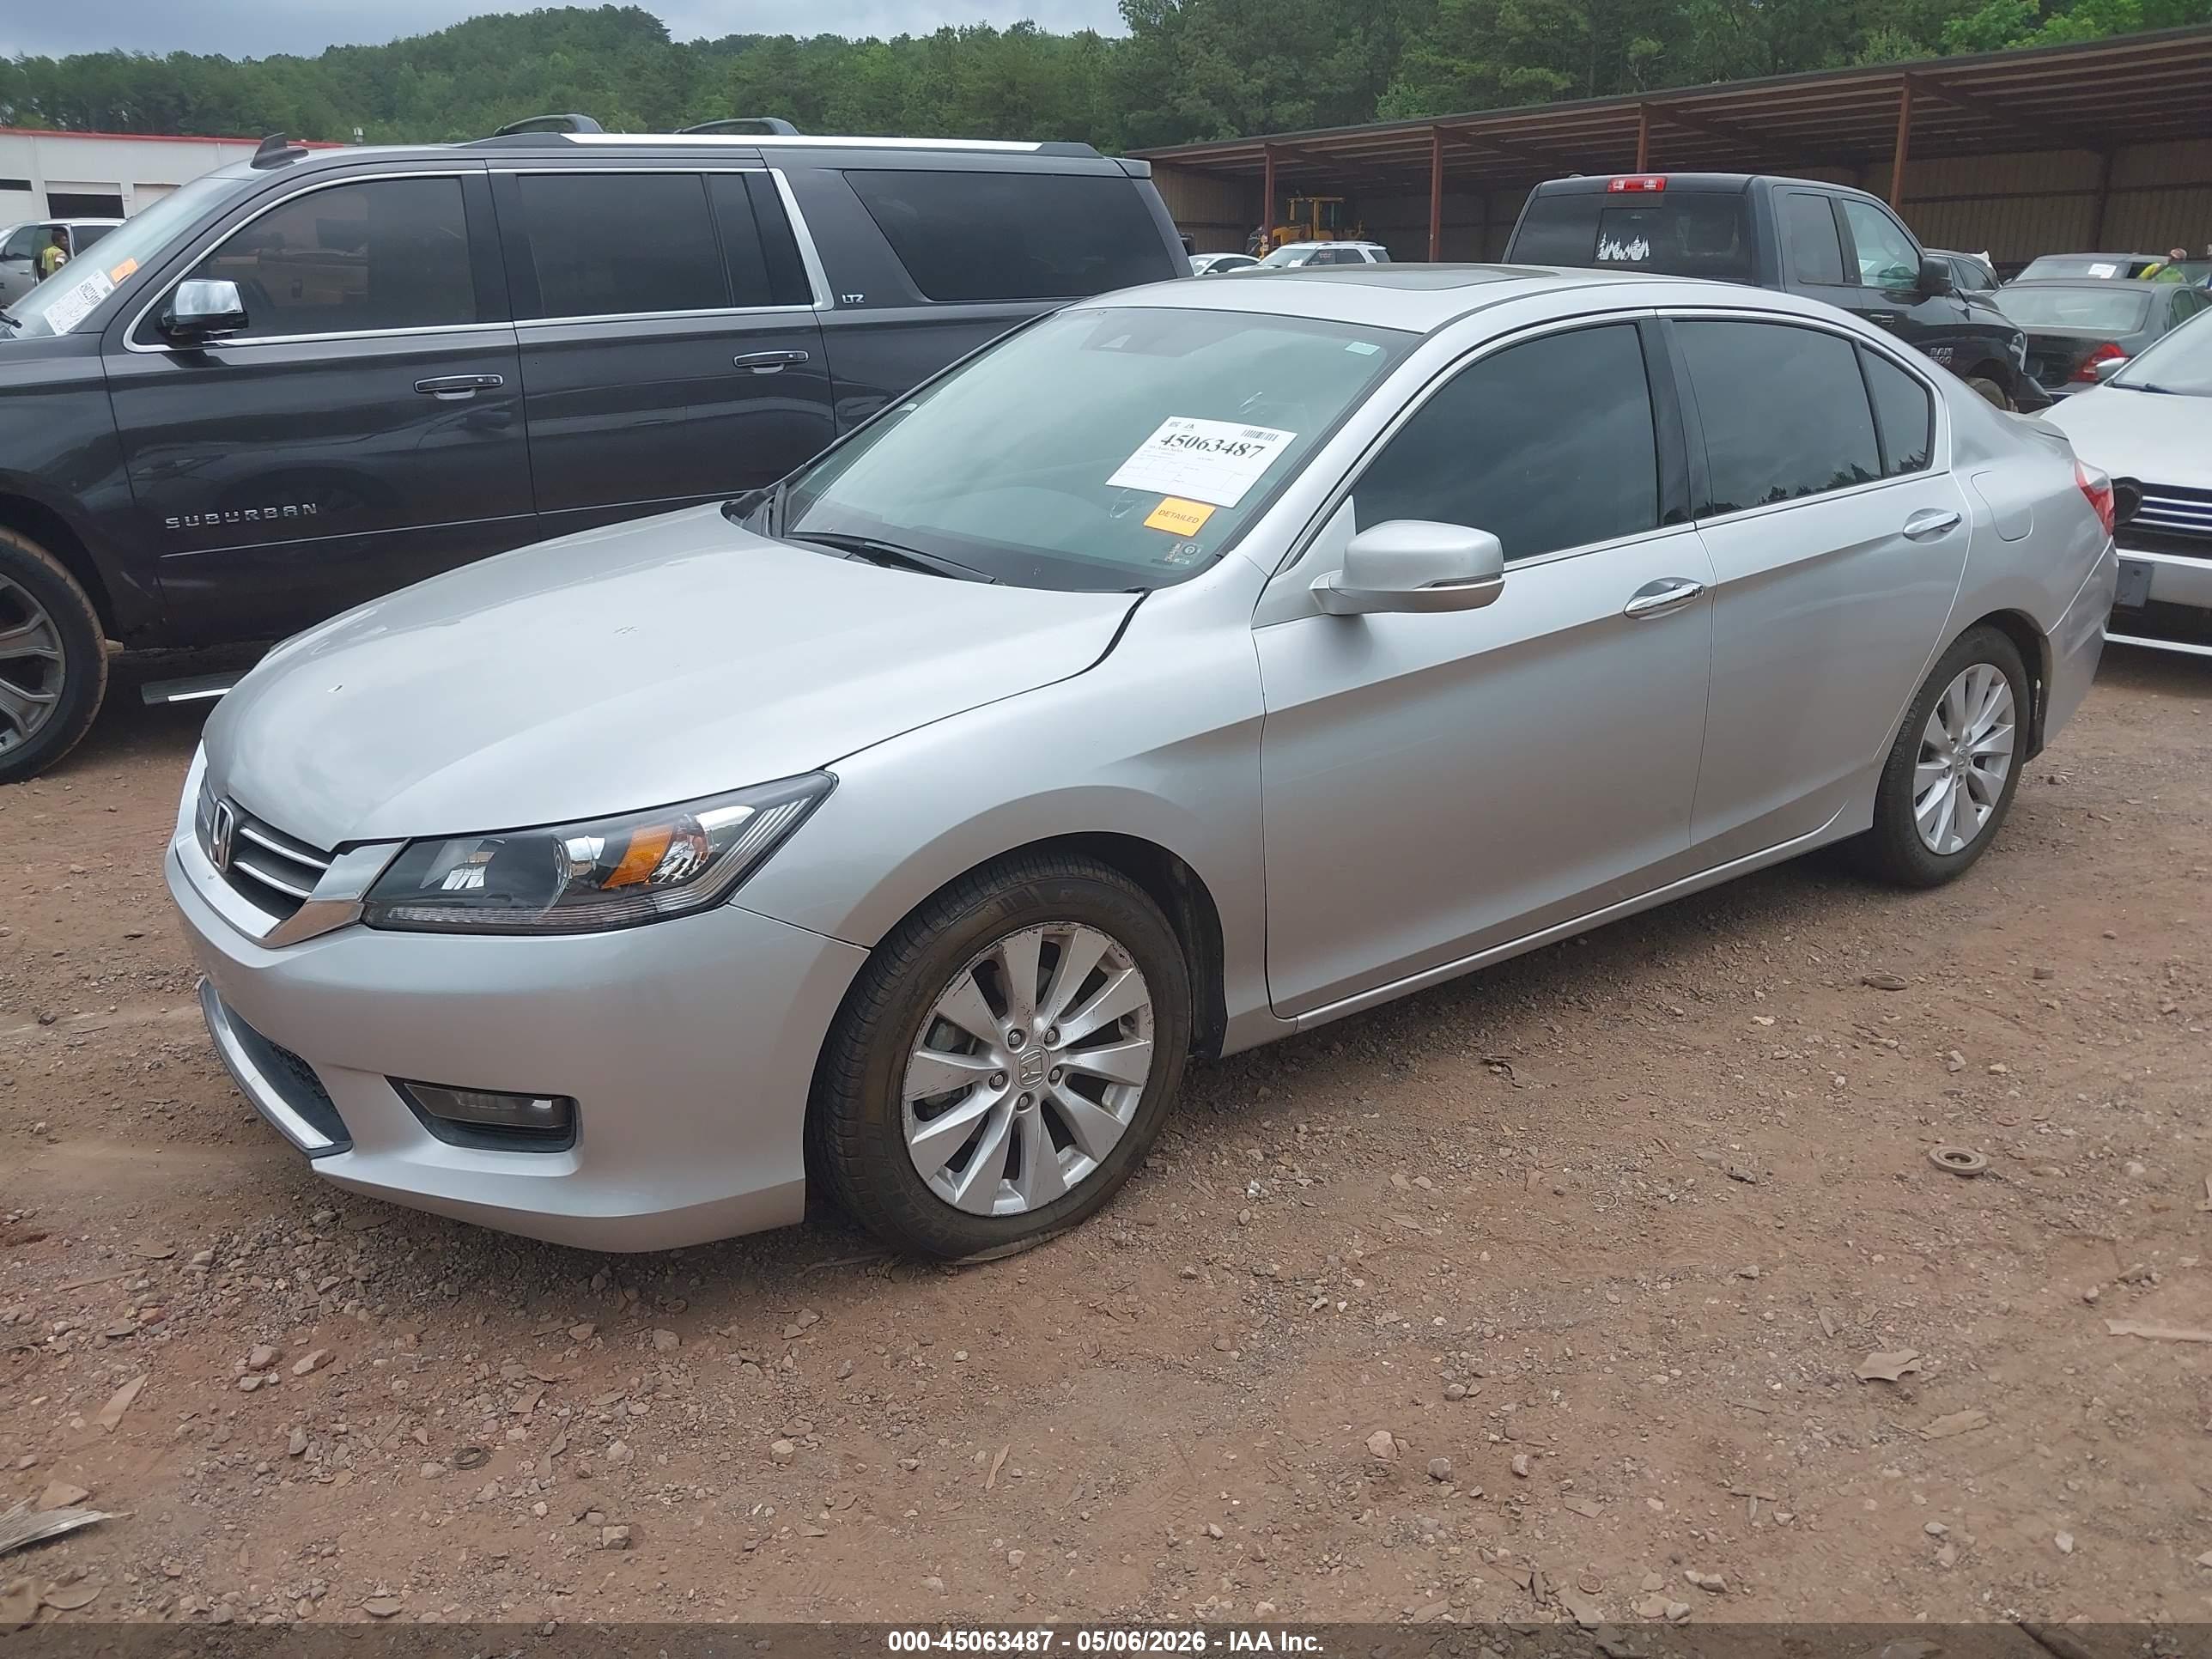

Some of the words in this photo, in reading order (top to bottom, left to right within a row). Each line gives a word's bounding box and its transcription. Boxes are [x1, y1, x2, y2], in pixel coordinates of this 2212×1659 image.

[842, 294, 865, 304] LTZ
[1929, 347, 1954, 356] RAM
[1160, 433, 1266, 459] 45063487
[165, 503, 317, 529] SUBURBAN
[1158, 509, 1200, 524] DETAILED
